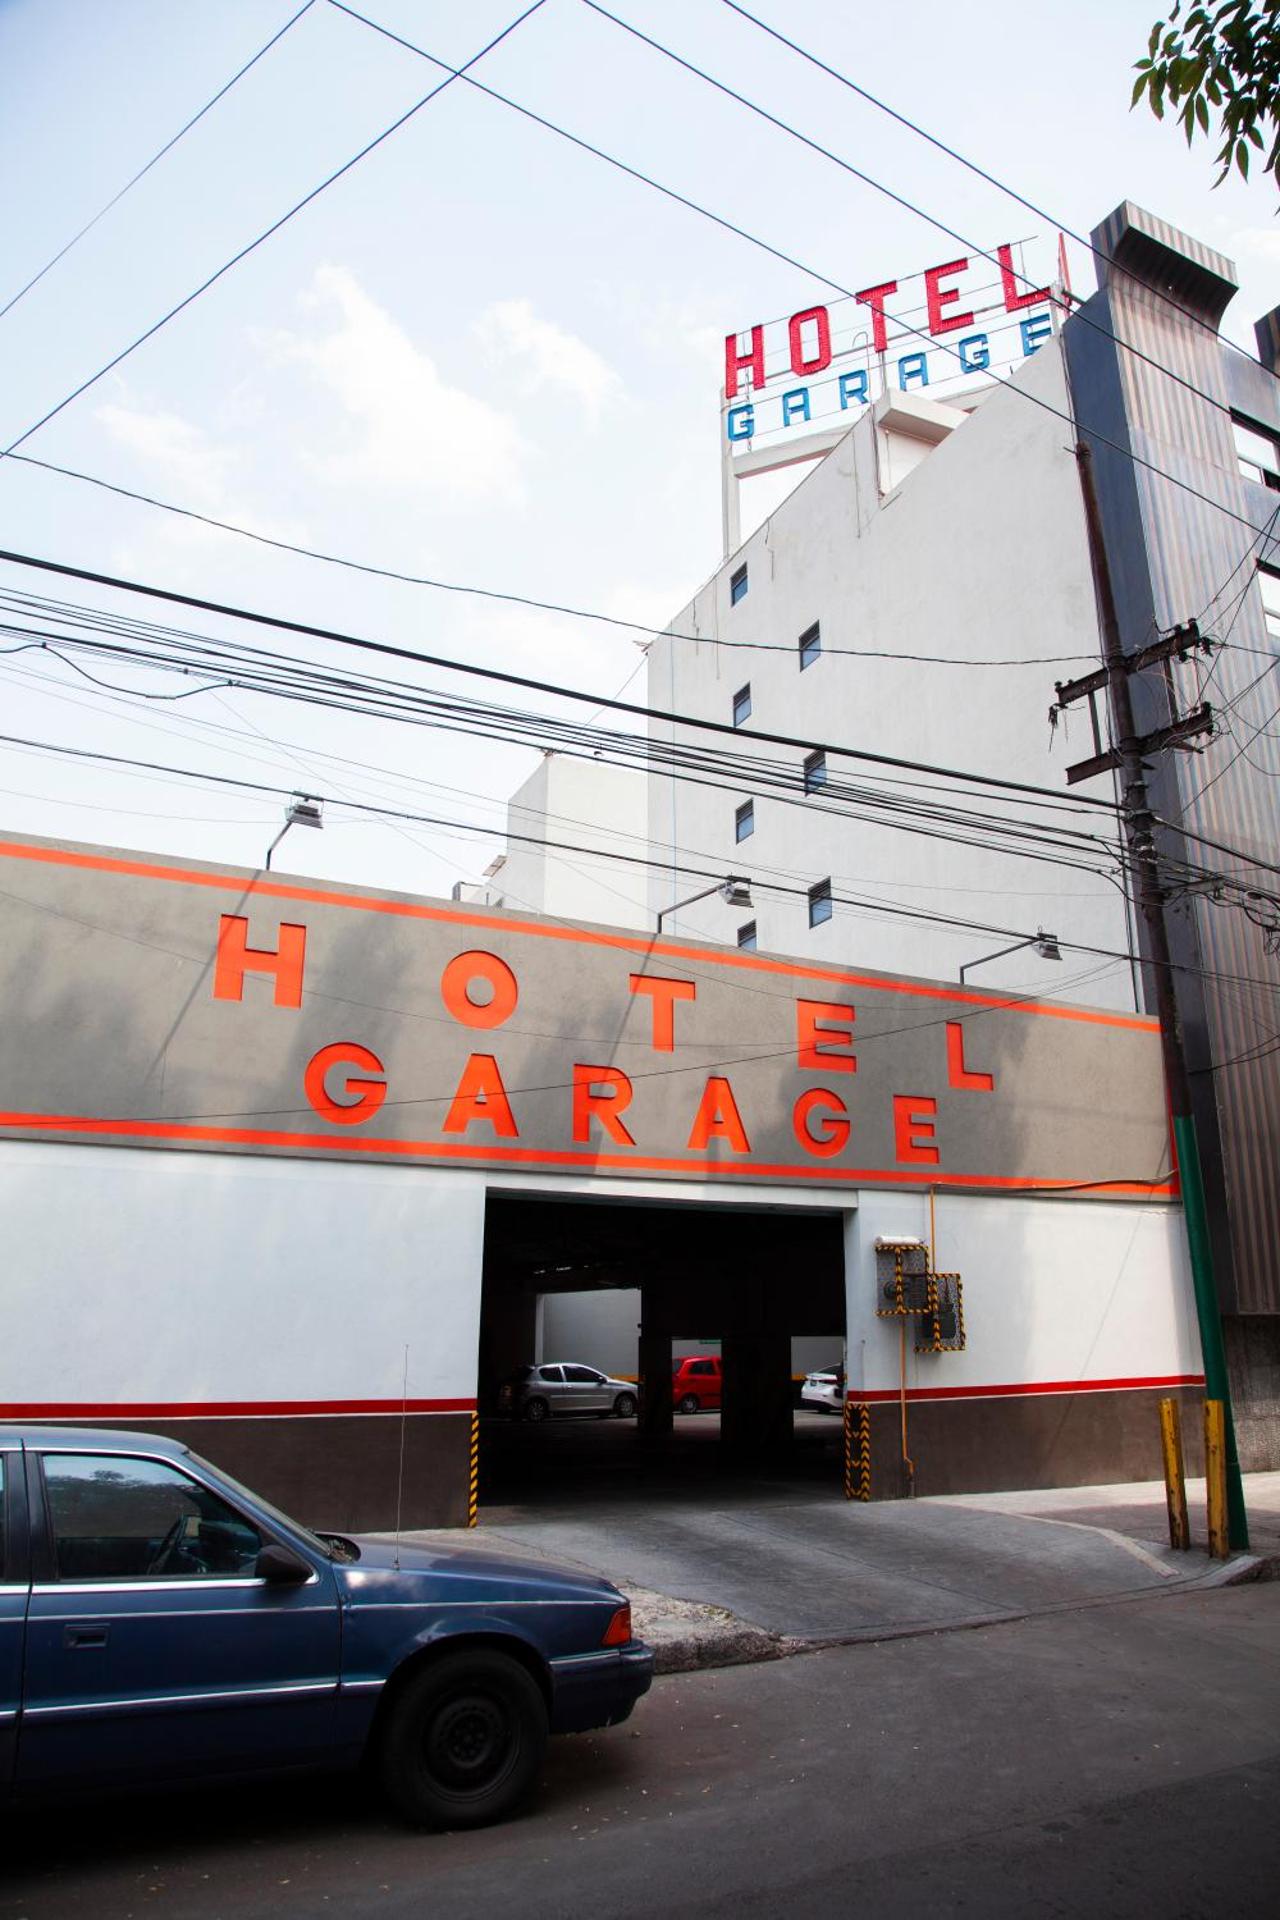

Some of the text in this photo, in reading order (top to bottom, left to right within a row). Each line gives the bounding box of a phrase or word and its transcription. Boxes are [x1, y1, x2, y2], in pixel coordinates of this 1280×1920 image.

[725, 244, 1052, 399] HOTEL
[727, 313, 1052, 441] GARAGE
[214, 914, 994, 1091] HOTEL
[304, 1042, 940, 1165] GARAGE
